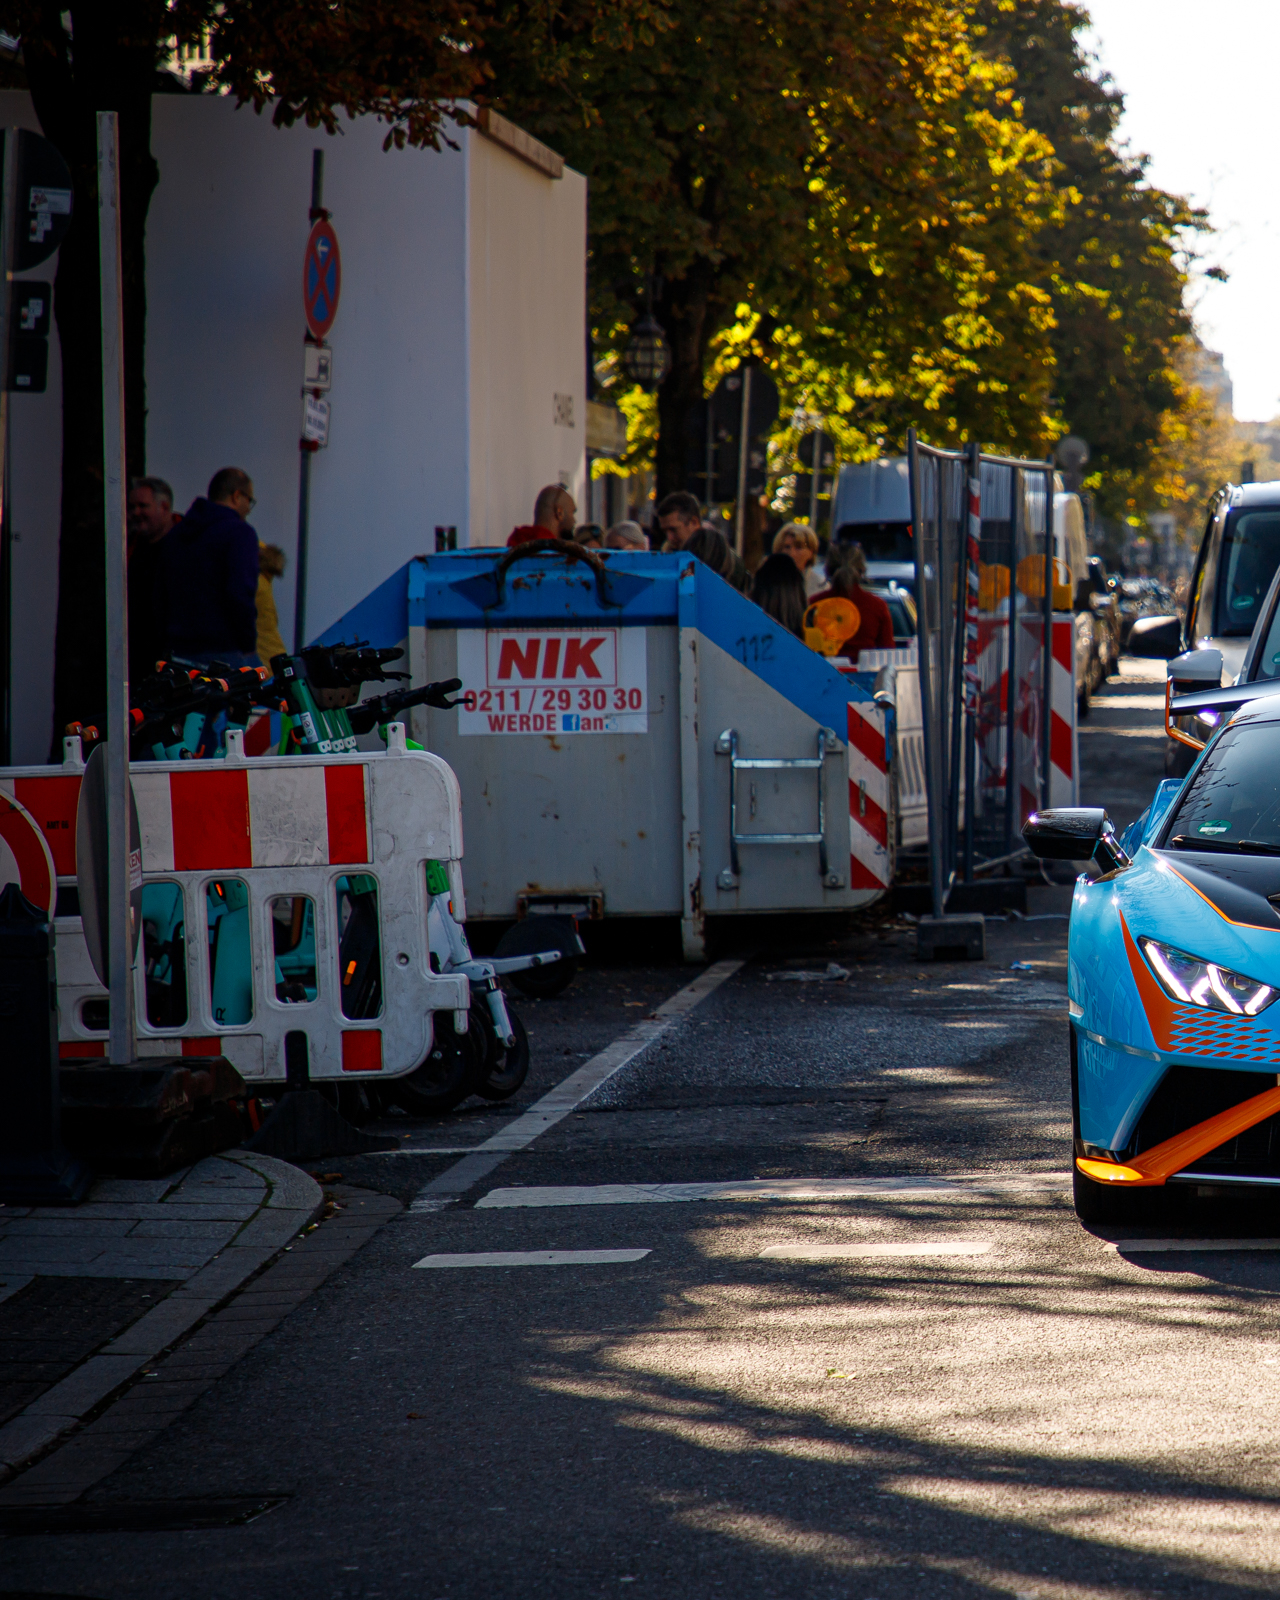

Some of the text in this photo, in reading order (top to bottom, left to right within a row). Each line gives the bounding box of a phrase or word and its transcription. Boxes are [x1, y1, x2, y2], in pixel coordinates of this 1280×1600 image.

[497, 637, 607, 680] NIK
[735, 634, 775, 664] 112
[542, 689, 571, 711] 29
[578, 689, 607, 711] 30
[613, 688, 642, 710] 30
[487, 714, 557, 732] WERDE
